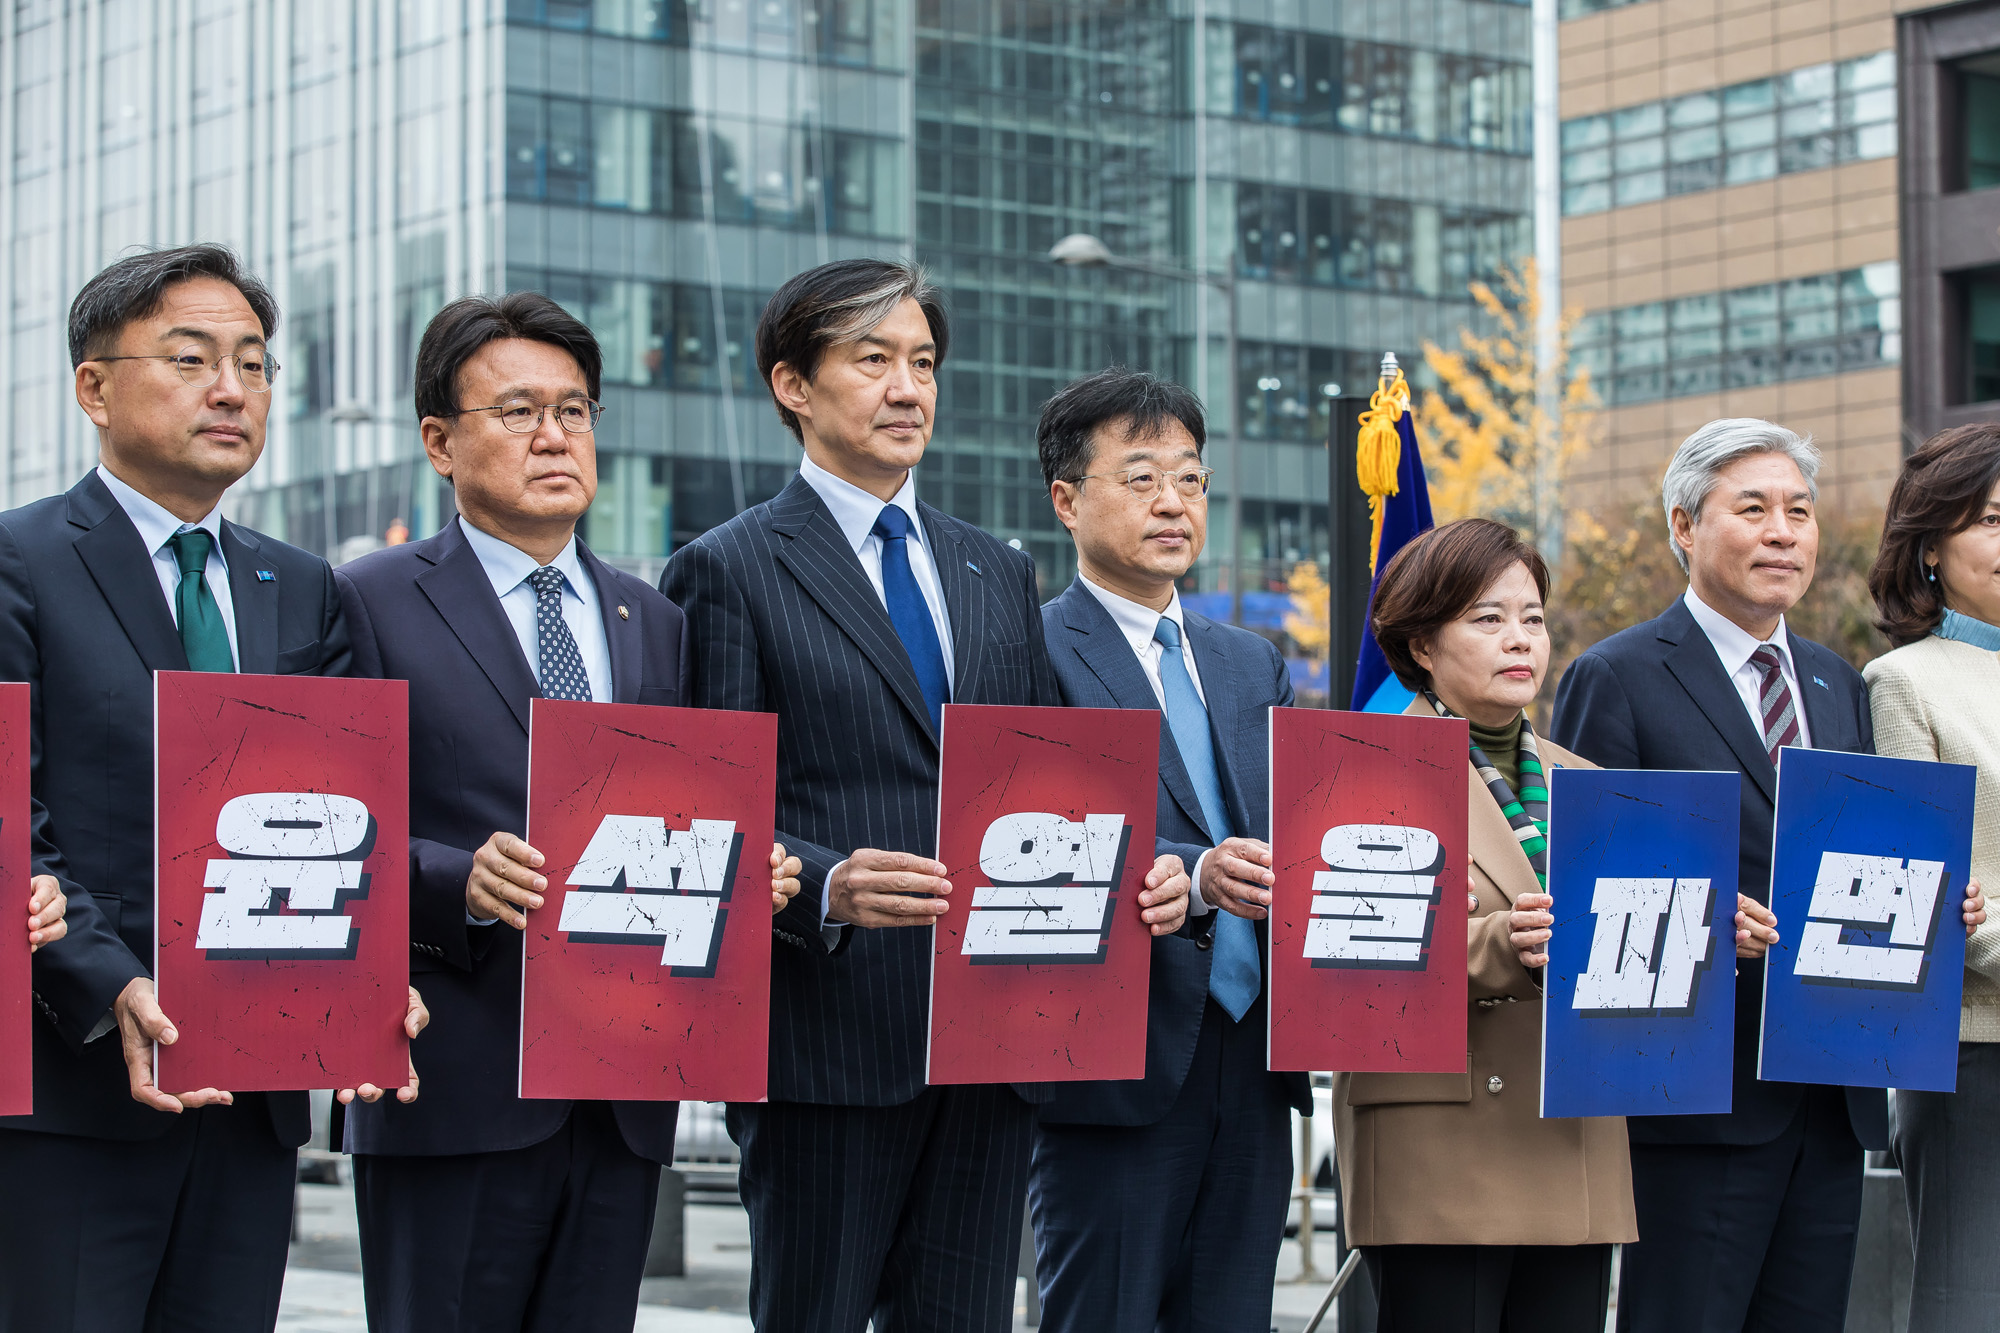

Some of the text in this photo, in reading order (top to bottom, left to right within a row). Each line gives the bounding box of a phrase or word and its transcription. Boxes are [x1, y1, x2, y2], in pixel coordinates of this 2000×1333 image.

[195, 793, 370, 950] 윤
[558, 814, 737, 967] 석
[961, 812, 1126, 955] 열
[1303, 824, 1439, 962] 을
[1794, 852, 1945, 984] 면
[1572, 878, 1712, 1010] 파
